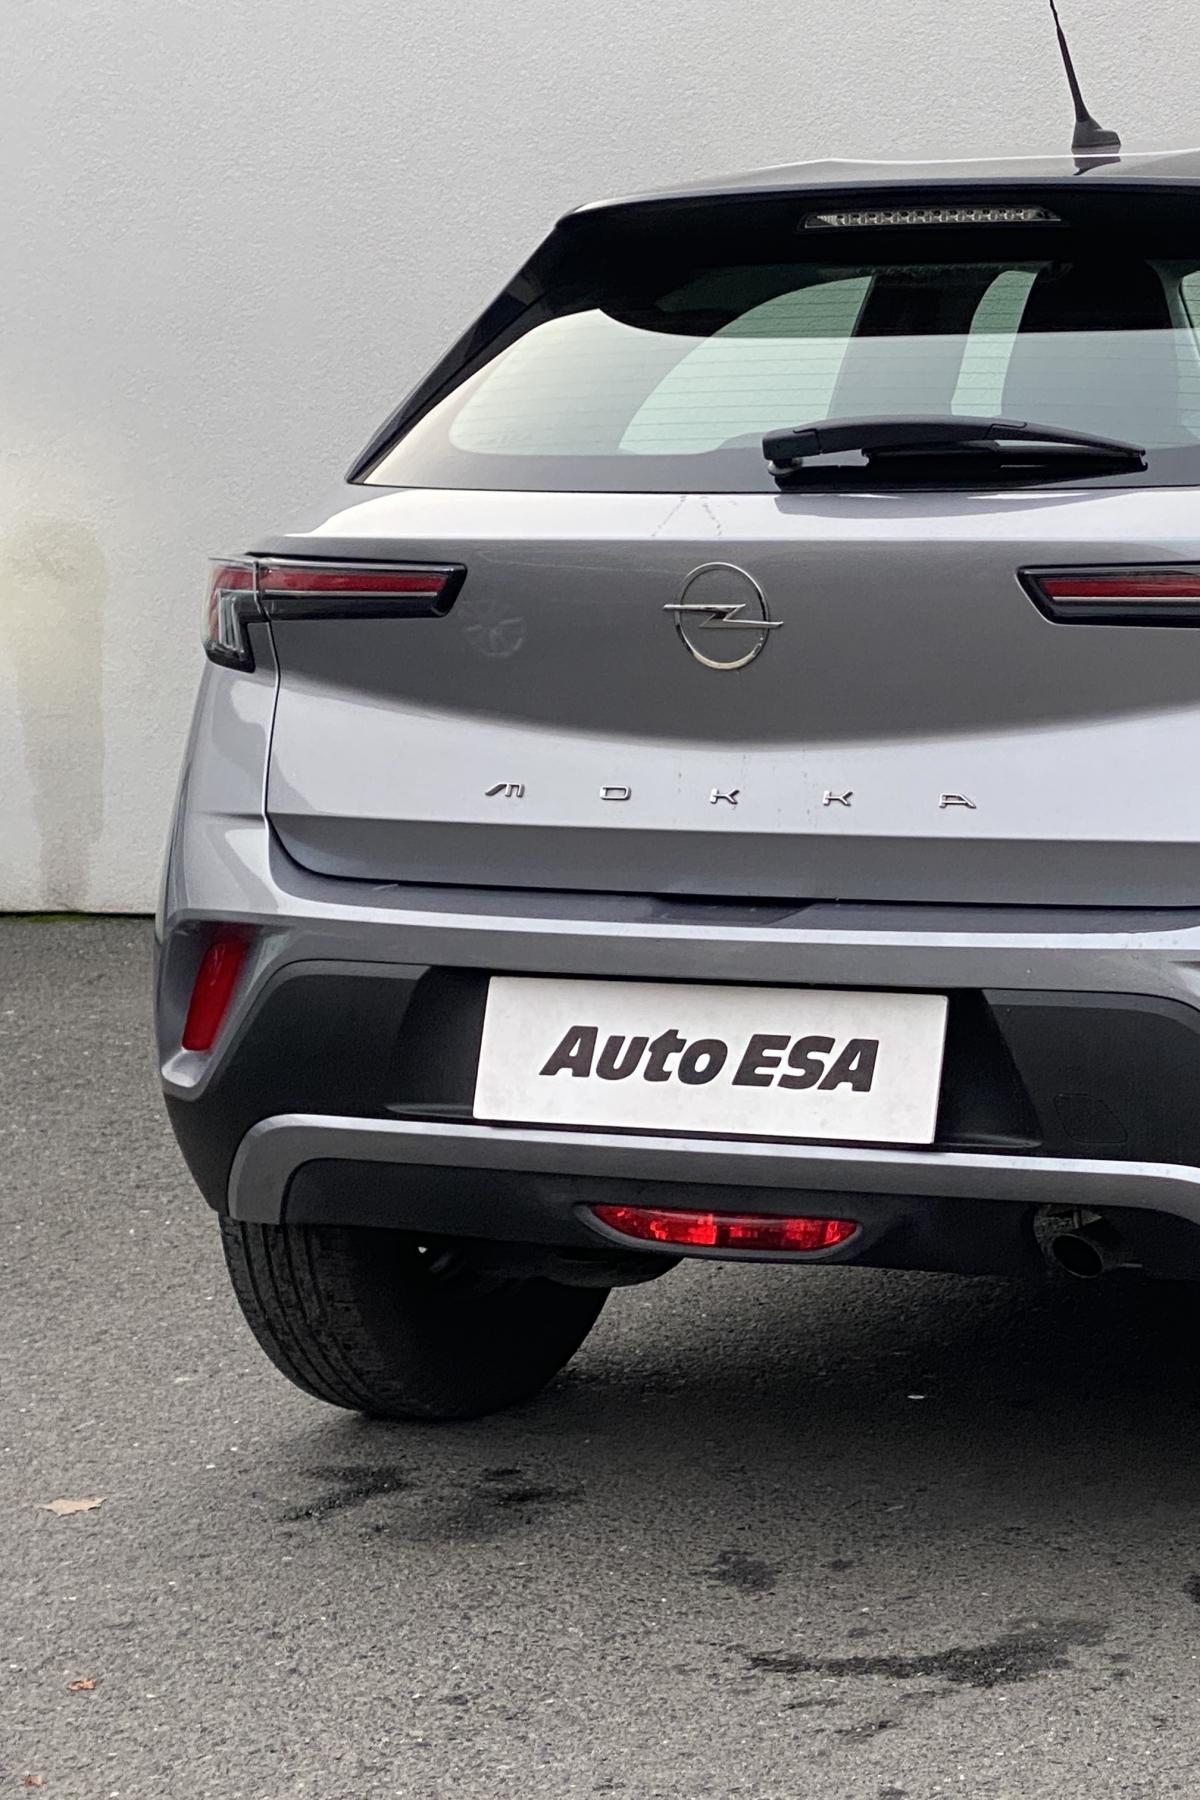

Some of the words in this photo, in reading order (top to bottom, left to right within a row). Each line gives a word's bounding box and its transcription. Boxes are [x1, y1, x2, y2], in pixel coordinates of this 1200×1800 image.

[485, 782, 977, 810] MOKKA
[539, 1025, 728, 1085] Auto
[732, 1034, 880, 1092] ESA
